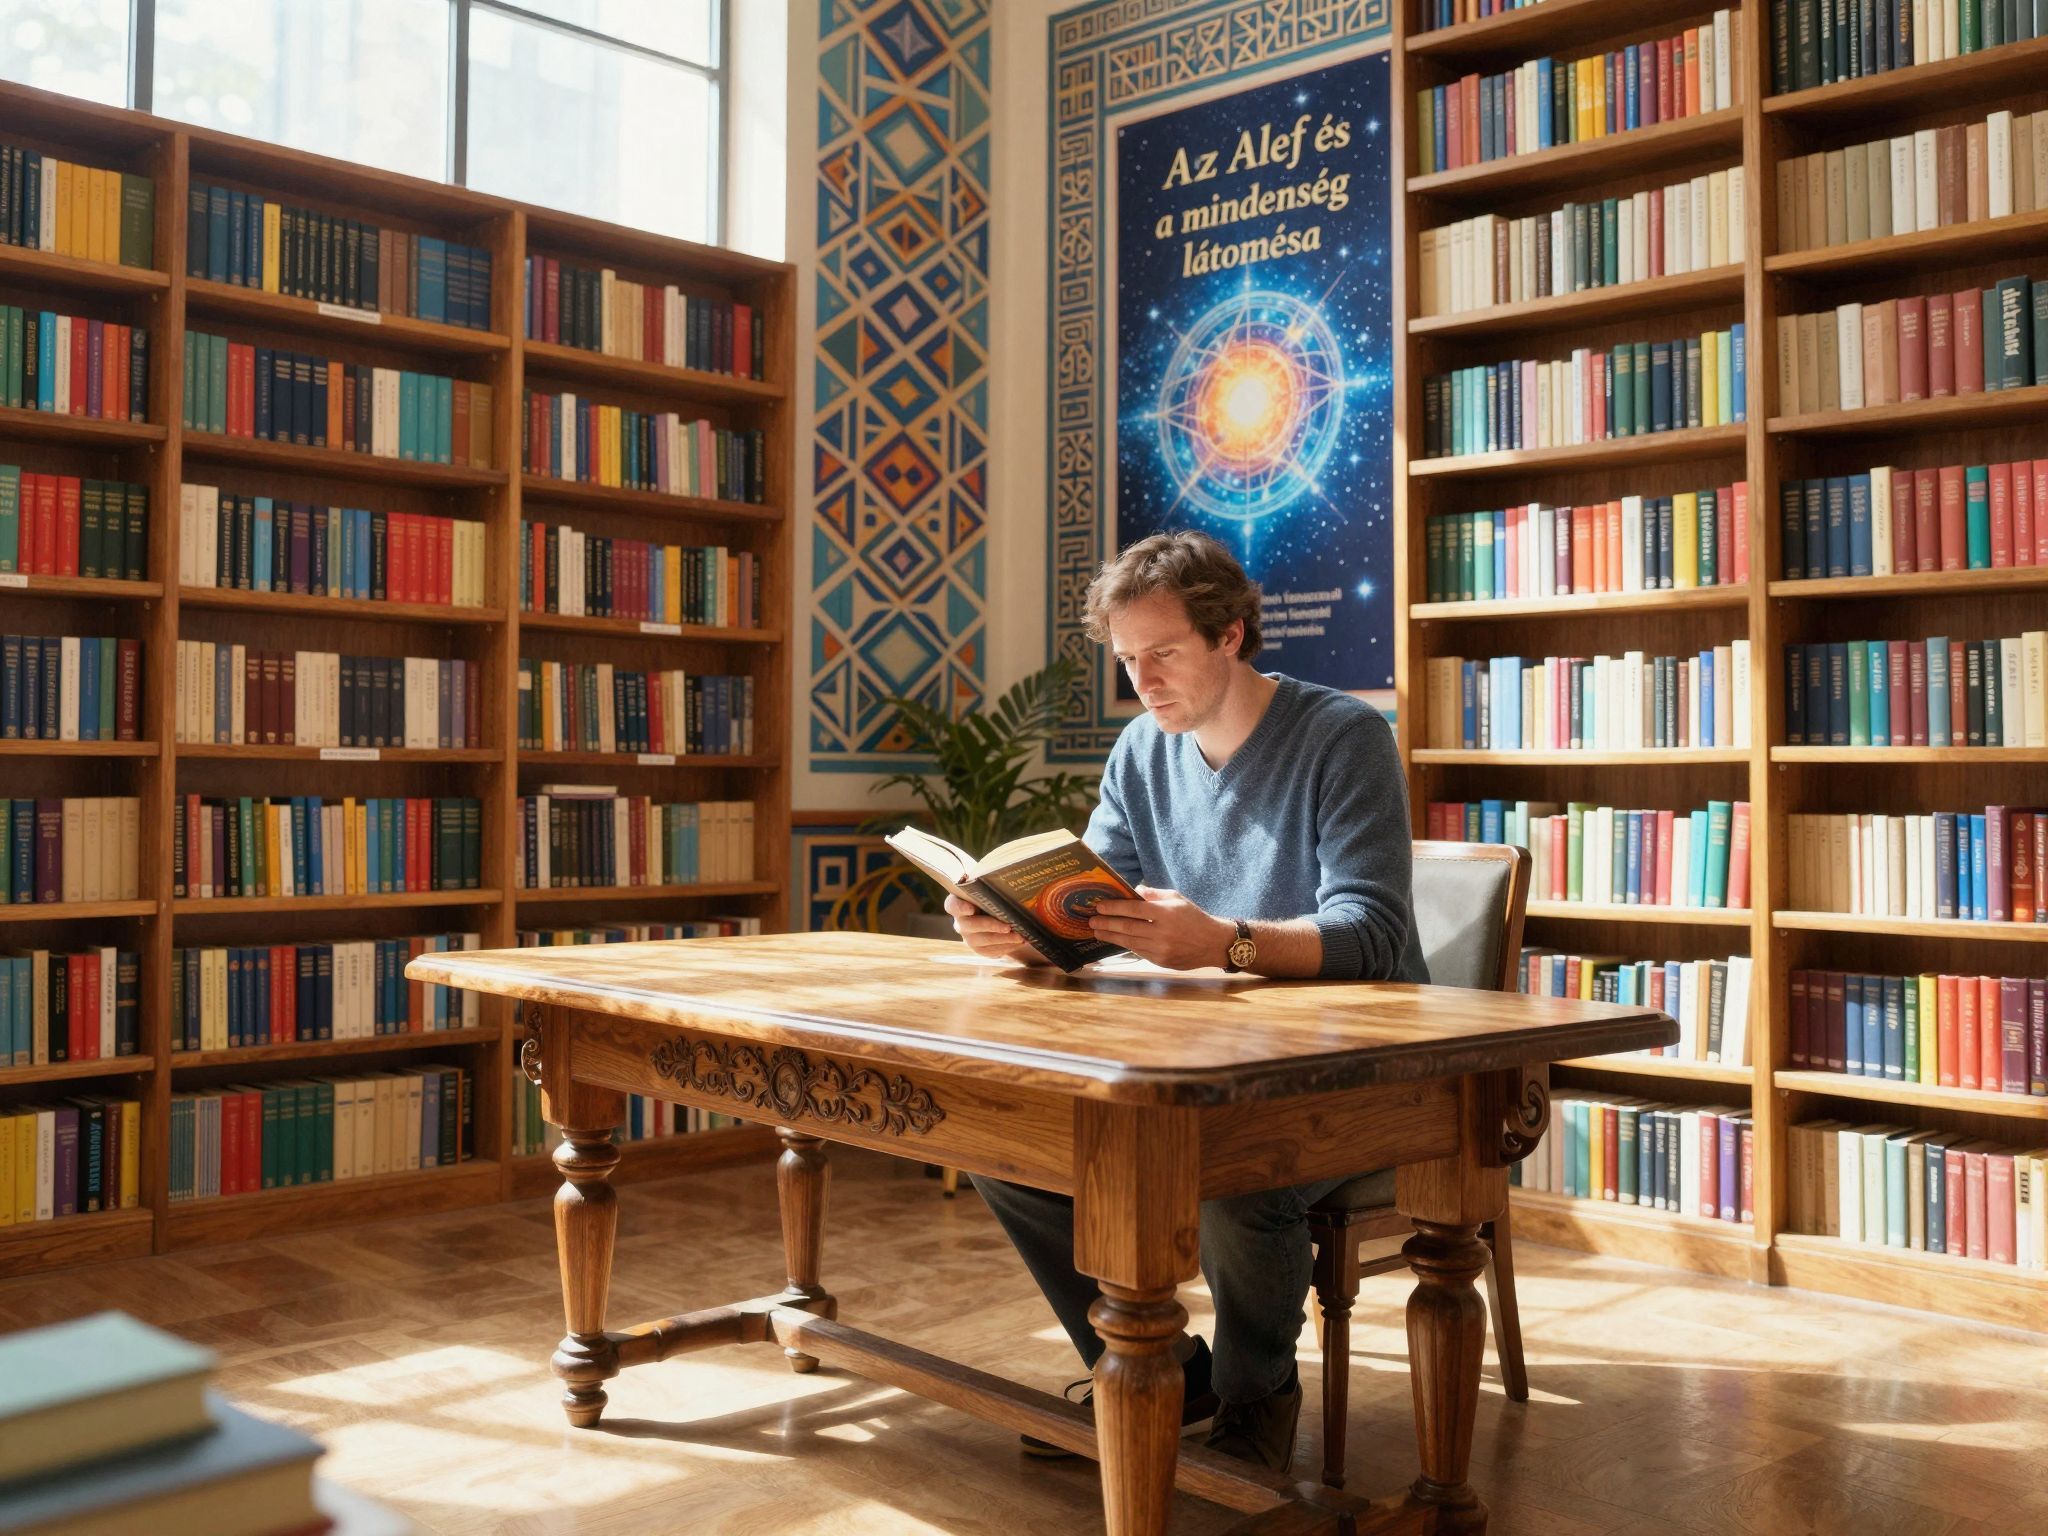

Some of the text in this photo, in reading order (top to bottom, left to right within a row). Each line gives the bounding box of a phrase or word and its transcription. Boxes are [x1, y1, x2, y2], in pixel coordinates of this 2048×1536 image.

[1161, 113, 1351, 190] Az Alef és
[1154, 167, 1351, 240] a mindenség
[1182, 223, 1322, 278] látomésa
